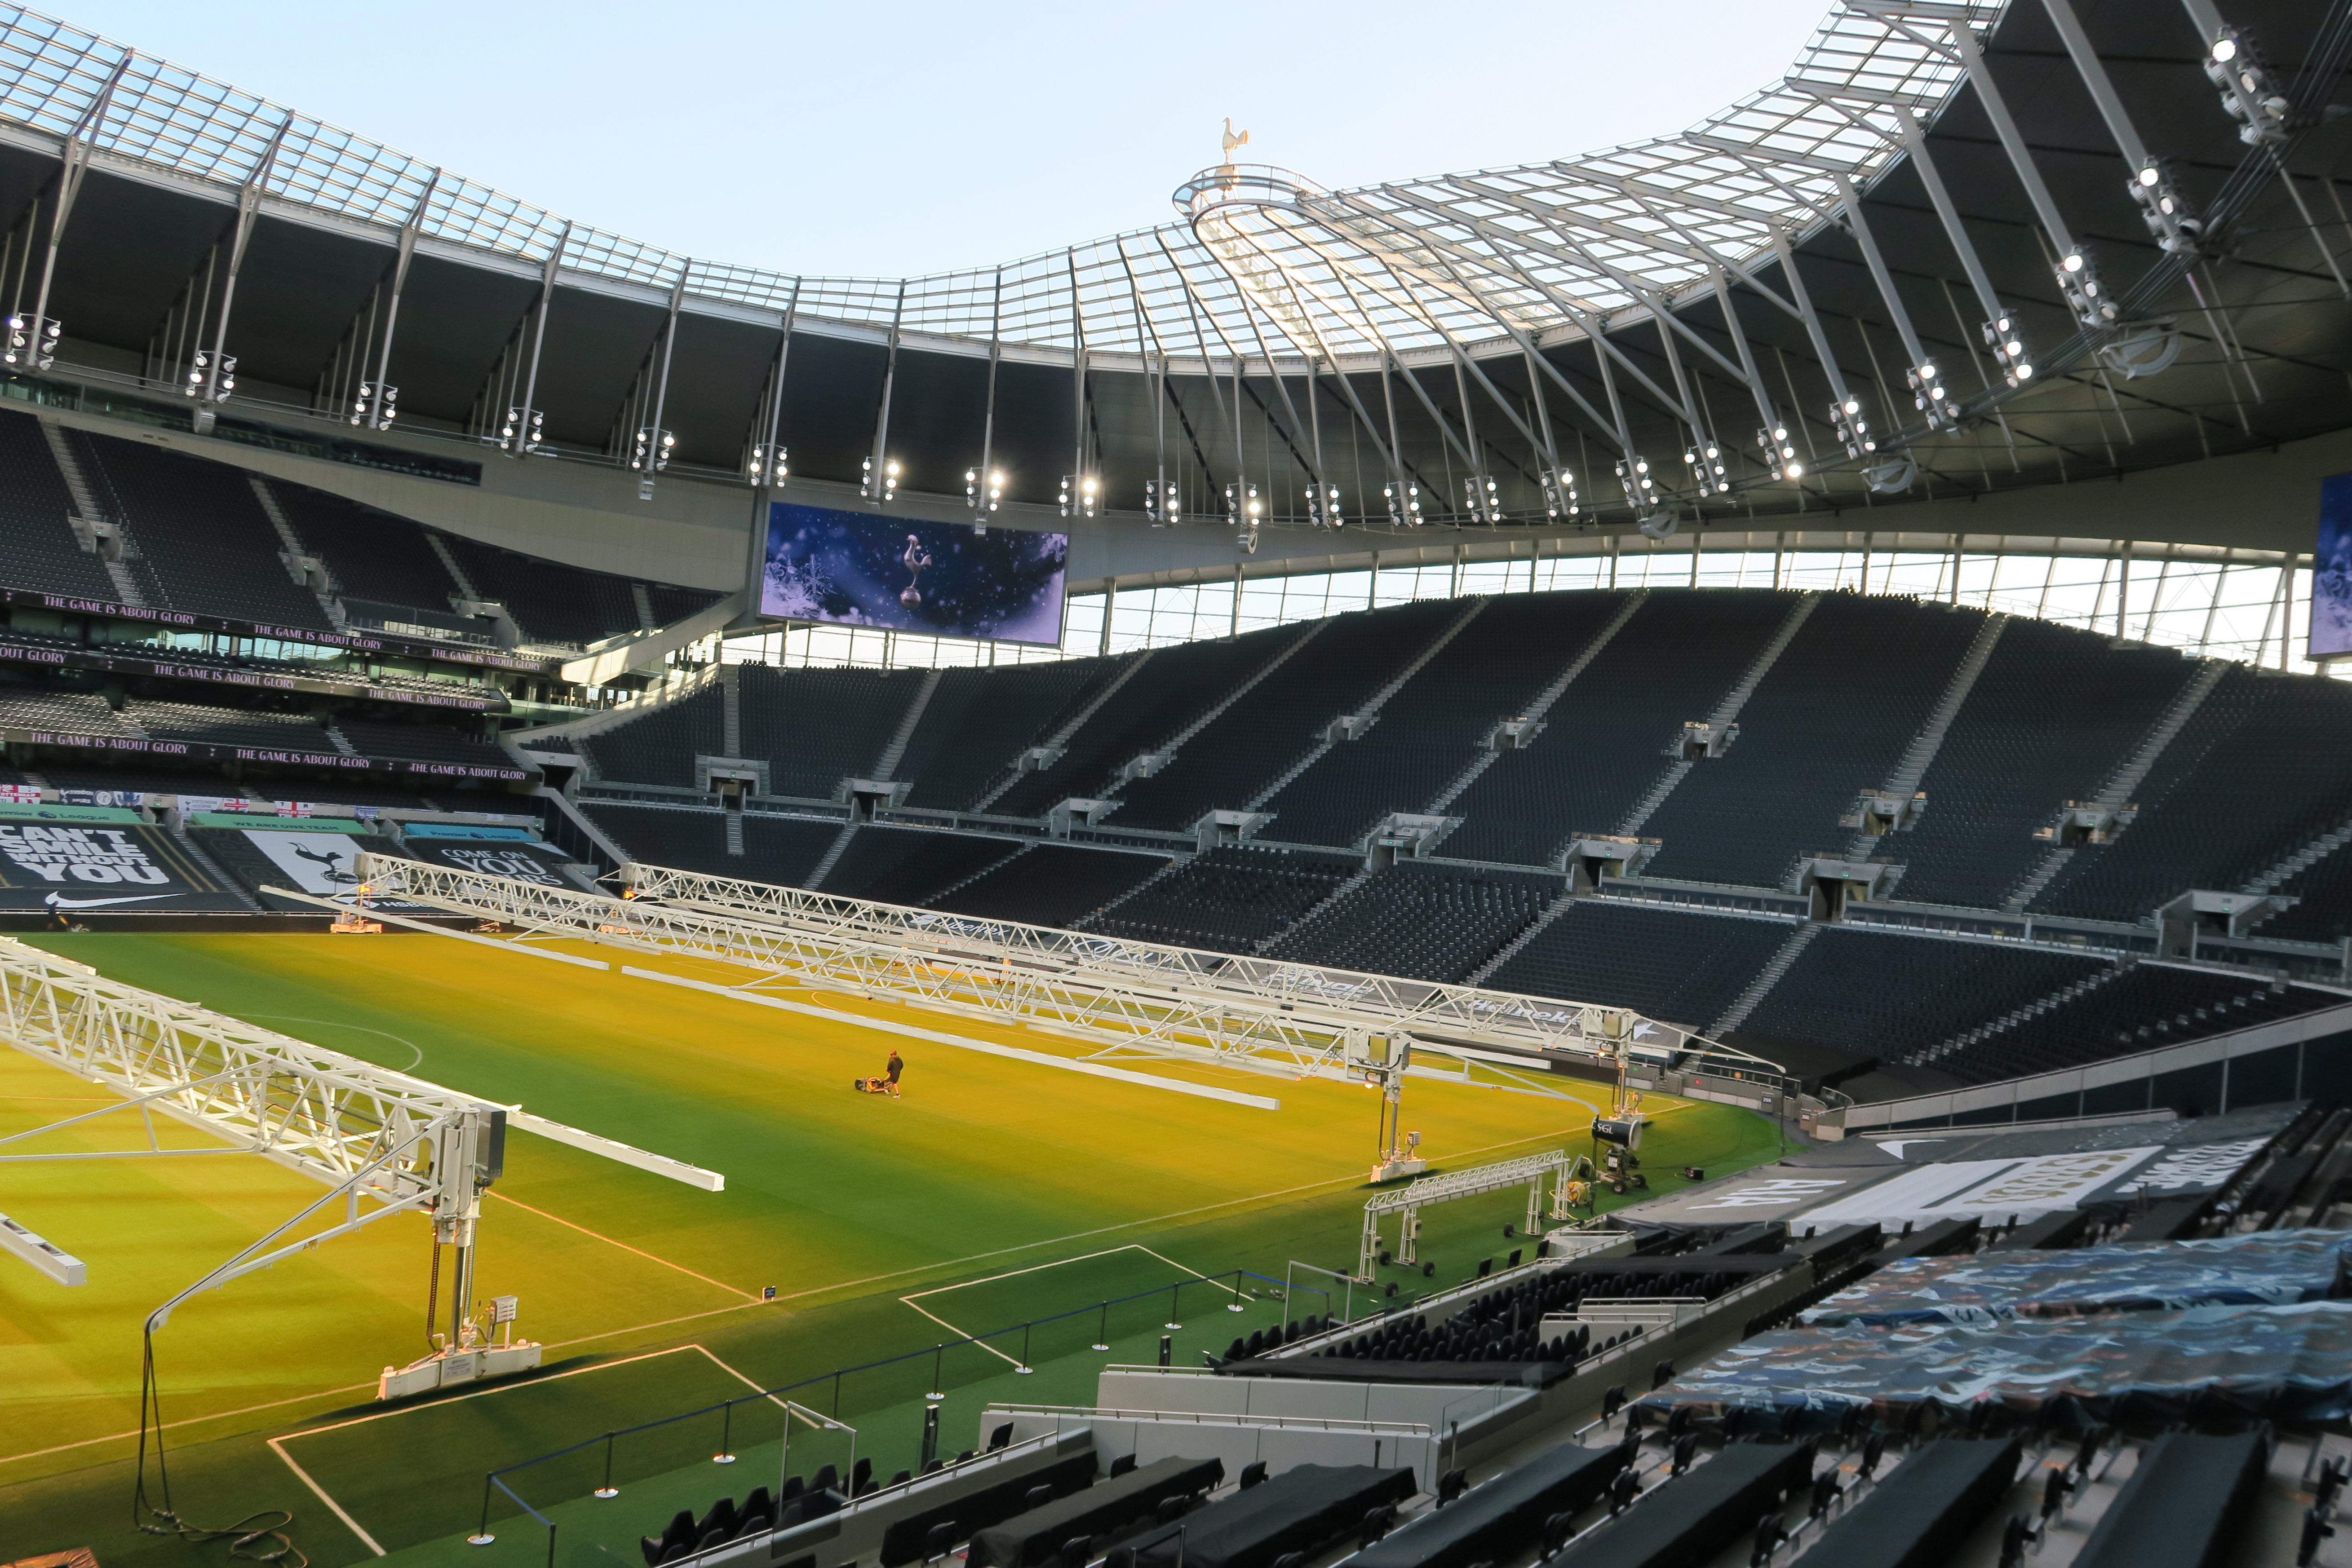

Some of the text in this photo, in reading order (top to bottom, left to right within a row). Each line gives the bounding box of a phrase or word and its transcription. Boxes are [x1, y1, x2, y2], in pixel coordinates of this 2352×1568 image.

[44, 596, 196, 624] THE GAME IS ABOUT GLORY
[254, 624, 382, 649] THE GAME IS ABOUT GLORY
[27, 650, 67, 663] GLORY
[432, 649, 542, 671] THE GAME IS ABOUT GLORY
[154, 664, 296, 688] THE GAME IS ABOUT GLORY
[369, 689, 487, 710] THE GAME IS ABOUT GLORY
[31, 732, 189, 754] THE GAME IS ABOUT GLORY
[236, 749, 371, 768] THE GAME IS ABOUT GLORY
[411, 763, 527, 781] THE GAME IS ABOUT GLORY
[0, 826, 126, 844] CAN'T
[0, 839, 147, 857] SMILE
[441, 849, 531, 860] COME ON
[7, 853, 150, 866] WITHOUT
[450, 858, 547, 875] YOU
[13, 862, 170, 884] YOU
[1597, 1123, 1614, 1134] SGL
